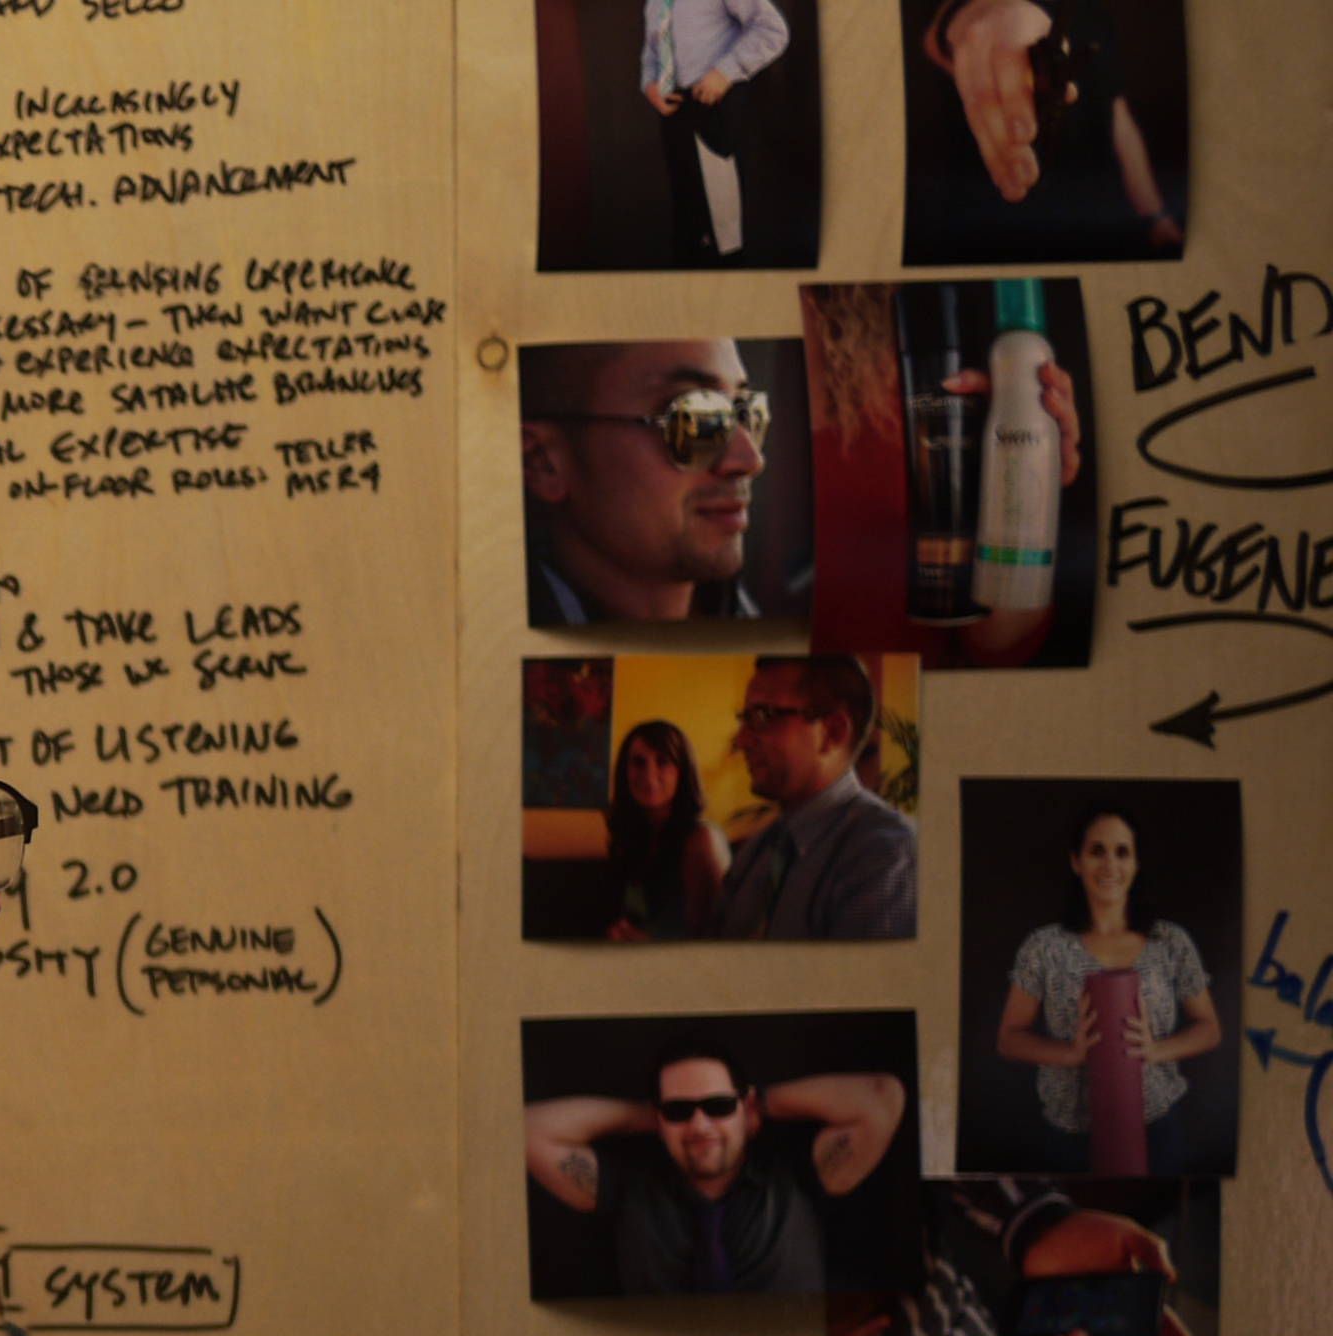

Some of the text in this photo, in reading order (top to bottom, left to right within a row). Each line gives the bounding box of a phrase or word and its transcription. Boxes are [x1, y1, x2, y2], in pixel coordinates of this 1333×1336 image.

[113, 157, 357, 206] ADVANCEMENT
[15, 266, 53, 301] OF
[258, 299, 358, 329] WANT
[1125, 262, 1333, 394] BEND
[0, 387, 86, 422] MORE
[64, 606, 159, 648] TAKE
[184, 601, 304, 645] LEADS
[9, 660, 104, 696] THOSE
[29, 728, 76, 769] OF
[94, 717, 300, 765] LISTENING
[51, 772, 355, 823] NEED TRAINING
[61, 857, 139, 900] 2.0
[143, 921, 297, 959] GENUINE
[43, 1263, 222, 1322] SYSTEM
